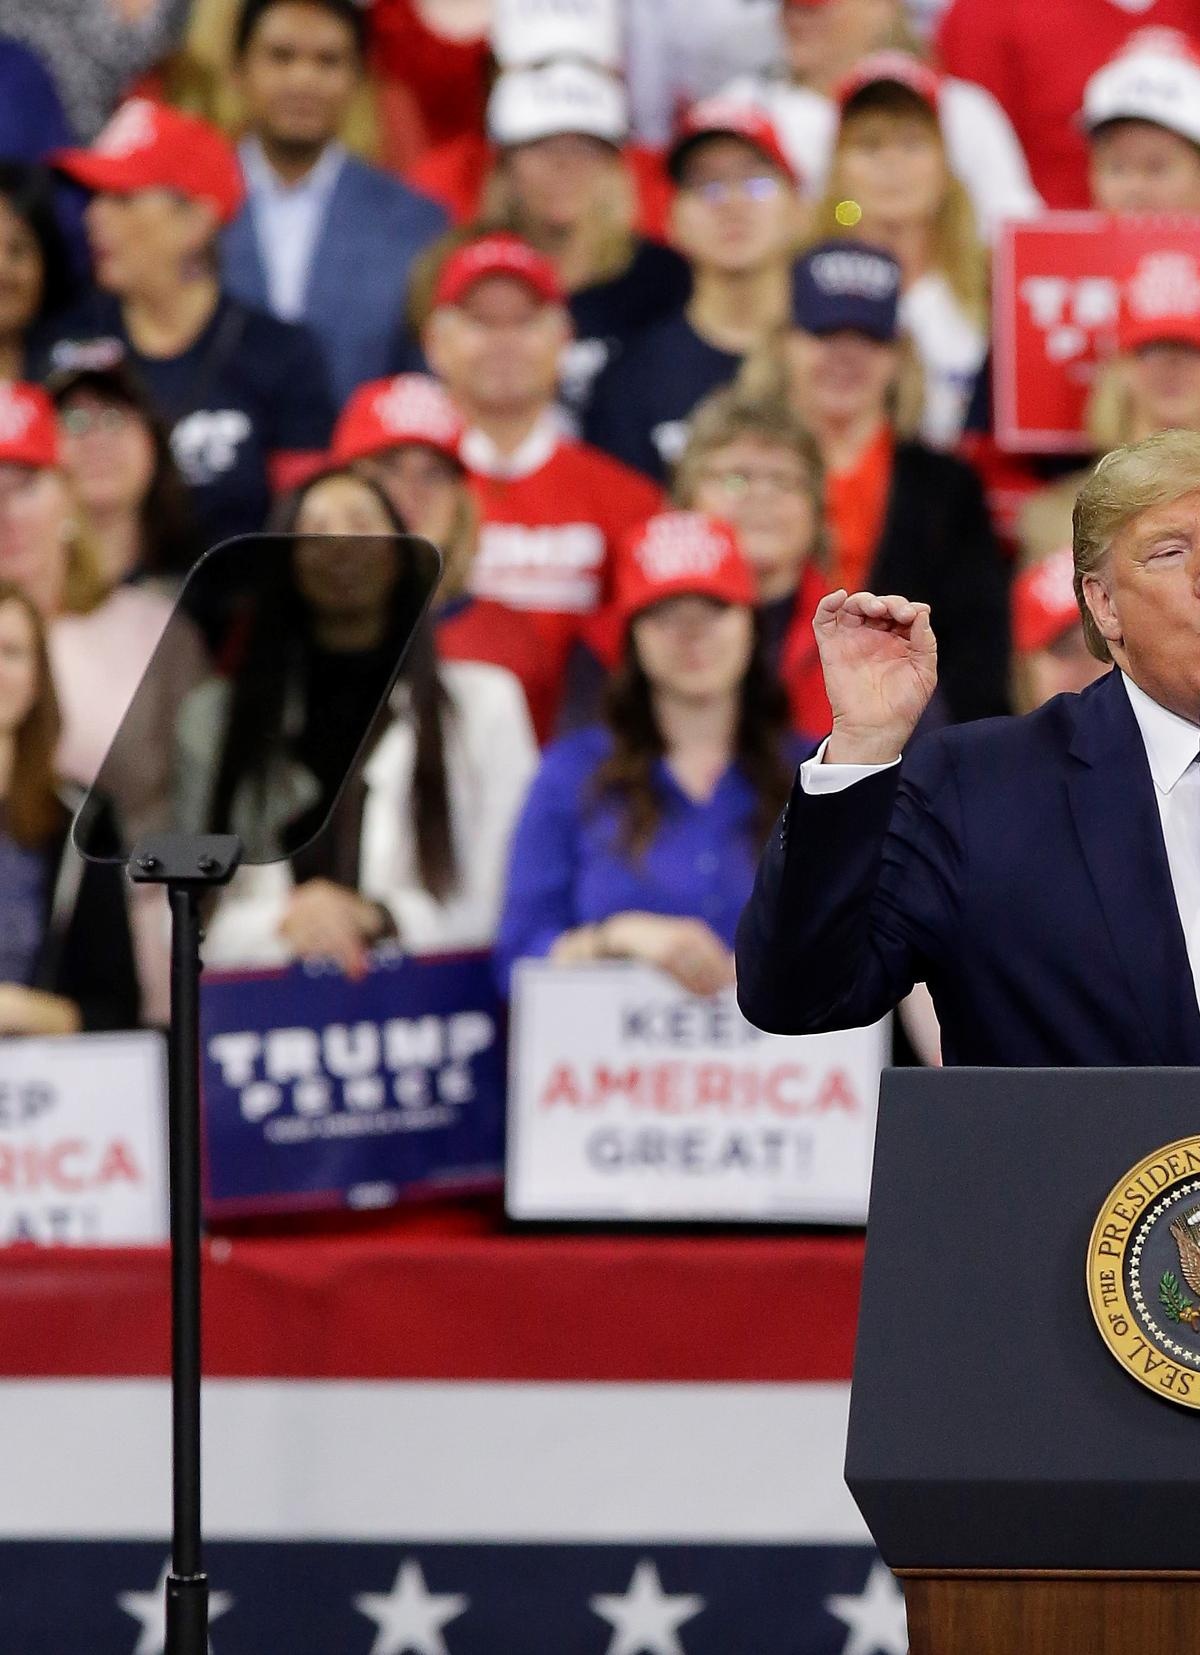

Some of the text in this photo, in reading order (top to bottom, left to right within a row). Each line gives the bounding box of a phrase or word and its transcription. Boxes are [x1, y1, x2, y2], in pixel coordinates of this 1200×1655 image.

[207, 1010, 496, 1088] TRUMP
[538, 1059, 864, 1114] AMERICA
[584, 1123, 814, 1178] GREAT!
[1101, 1269, 1117, 1307] THE
[1109, 1313, 1129, 1337] OF
[1127, 1335, 1195, 1396] SEAL
